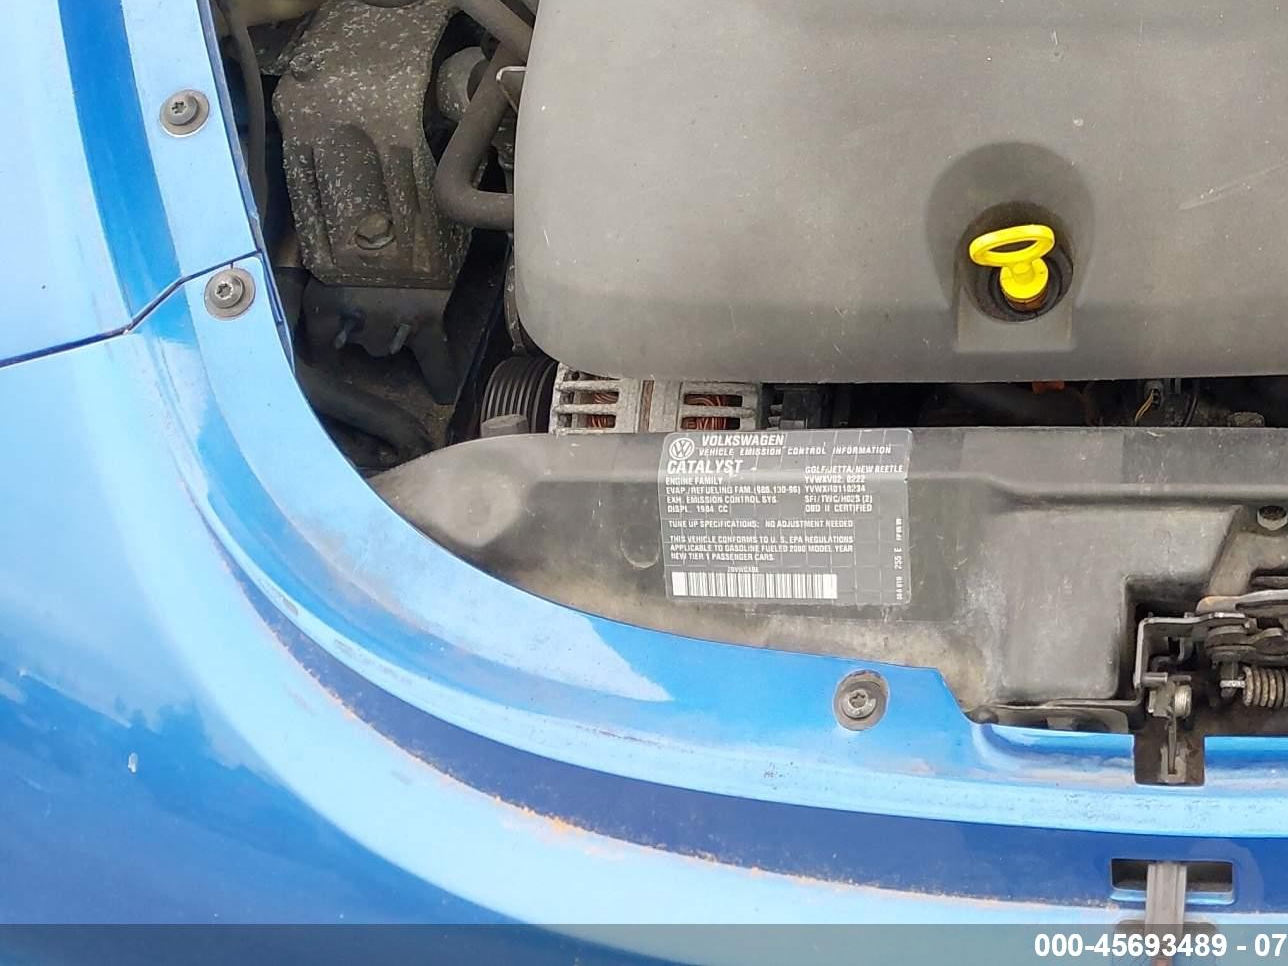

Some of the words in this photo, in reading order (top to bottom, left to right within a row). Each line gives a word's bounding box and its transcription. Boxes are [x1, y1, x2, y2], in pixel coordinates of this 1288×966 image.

[702, 434, 785, 446] VOLKSWAGEN
[699, 448, 734, 456] VEHICLE
[740, 448, 782, 456] EMISSION
[788, 447, 827, 455] CONTROL
[832, 446, 892, 454] INFORMATION
[667, 459, 743, 474] CATALYST
[874, 465, 904, 473] BEETLE
[665, 477, 693, 485] ENGINE
[695, 476, 723, 485] FAMILY
[686, 496, 723, 504] EMISSION
[725, 496, 760, 504] CONTROL
[718, 505, 729, 513] CC
[765, 520, 775, 528] NO
[718, 536, 758, 544] CONFORMS
[725, 544, 760, 552] GASOLINE
